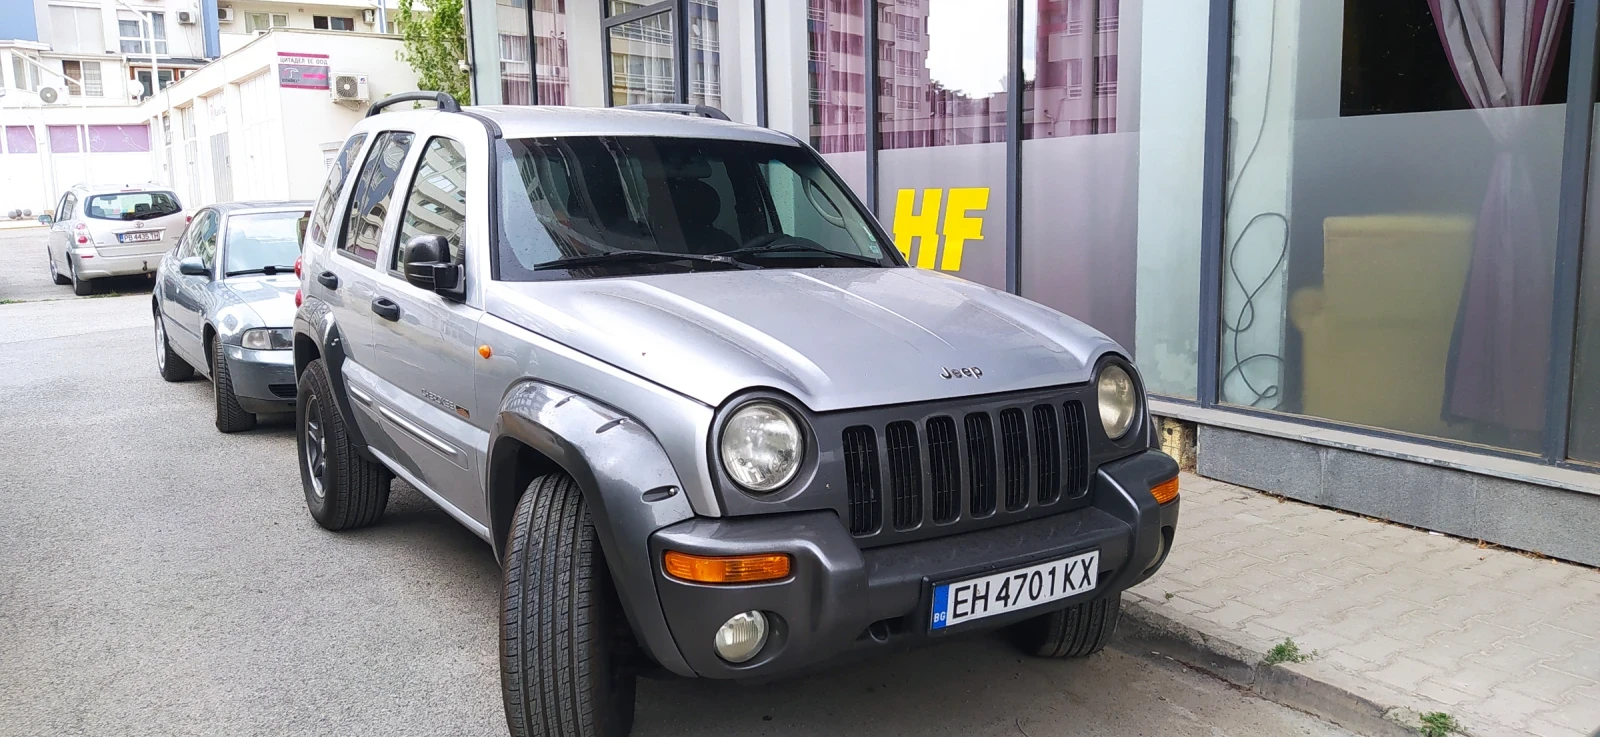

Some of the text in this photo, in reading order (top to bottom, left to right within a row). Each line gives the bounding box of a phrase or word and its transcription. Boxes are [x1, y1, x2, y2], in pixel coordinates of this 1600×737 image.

[892, 187, 990, 271] HF
[939, 366, 983, 380] Jeep
[952, 556, 1095, 620] EH 4701 KX
[933, 611, 946, 624] BG
